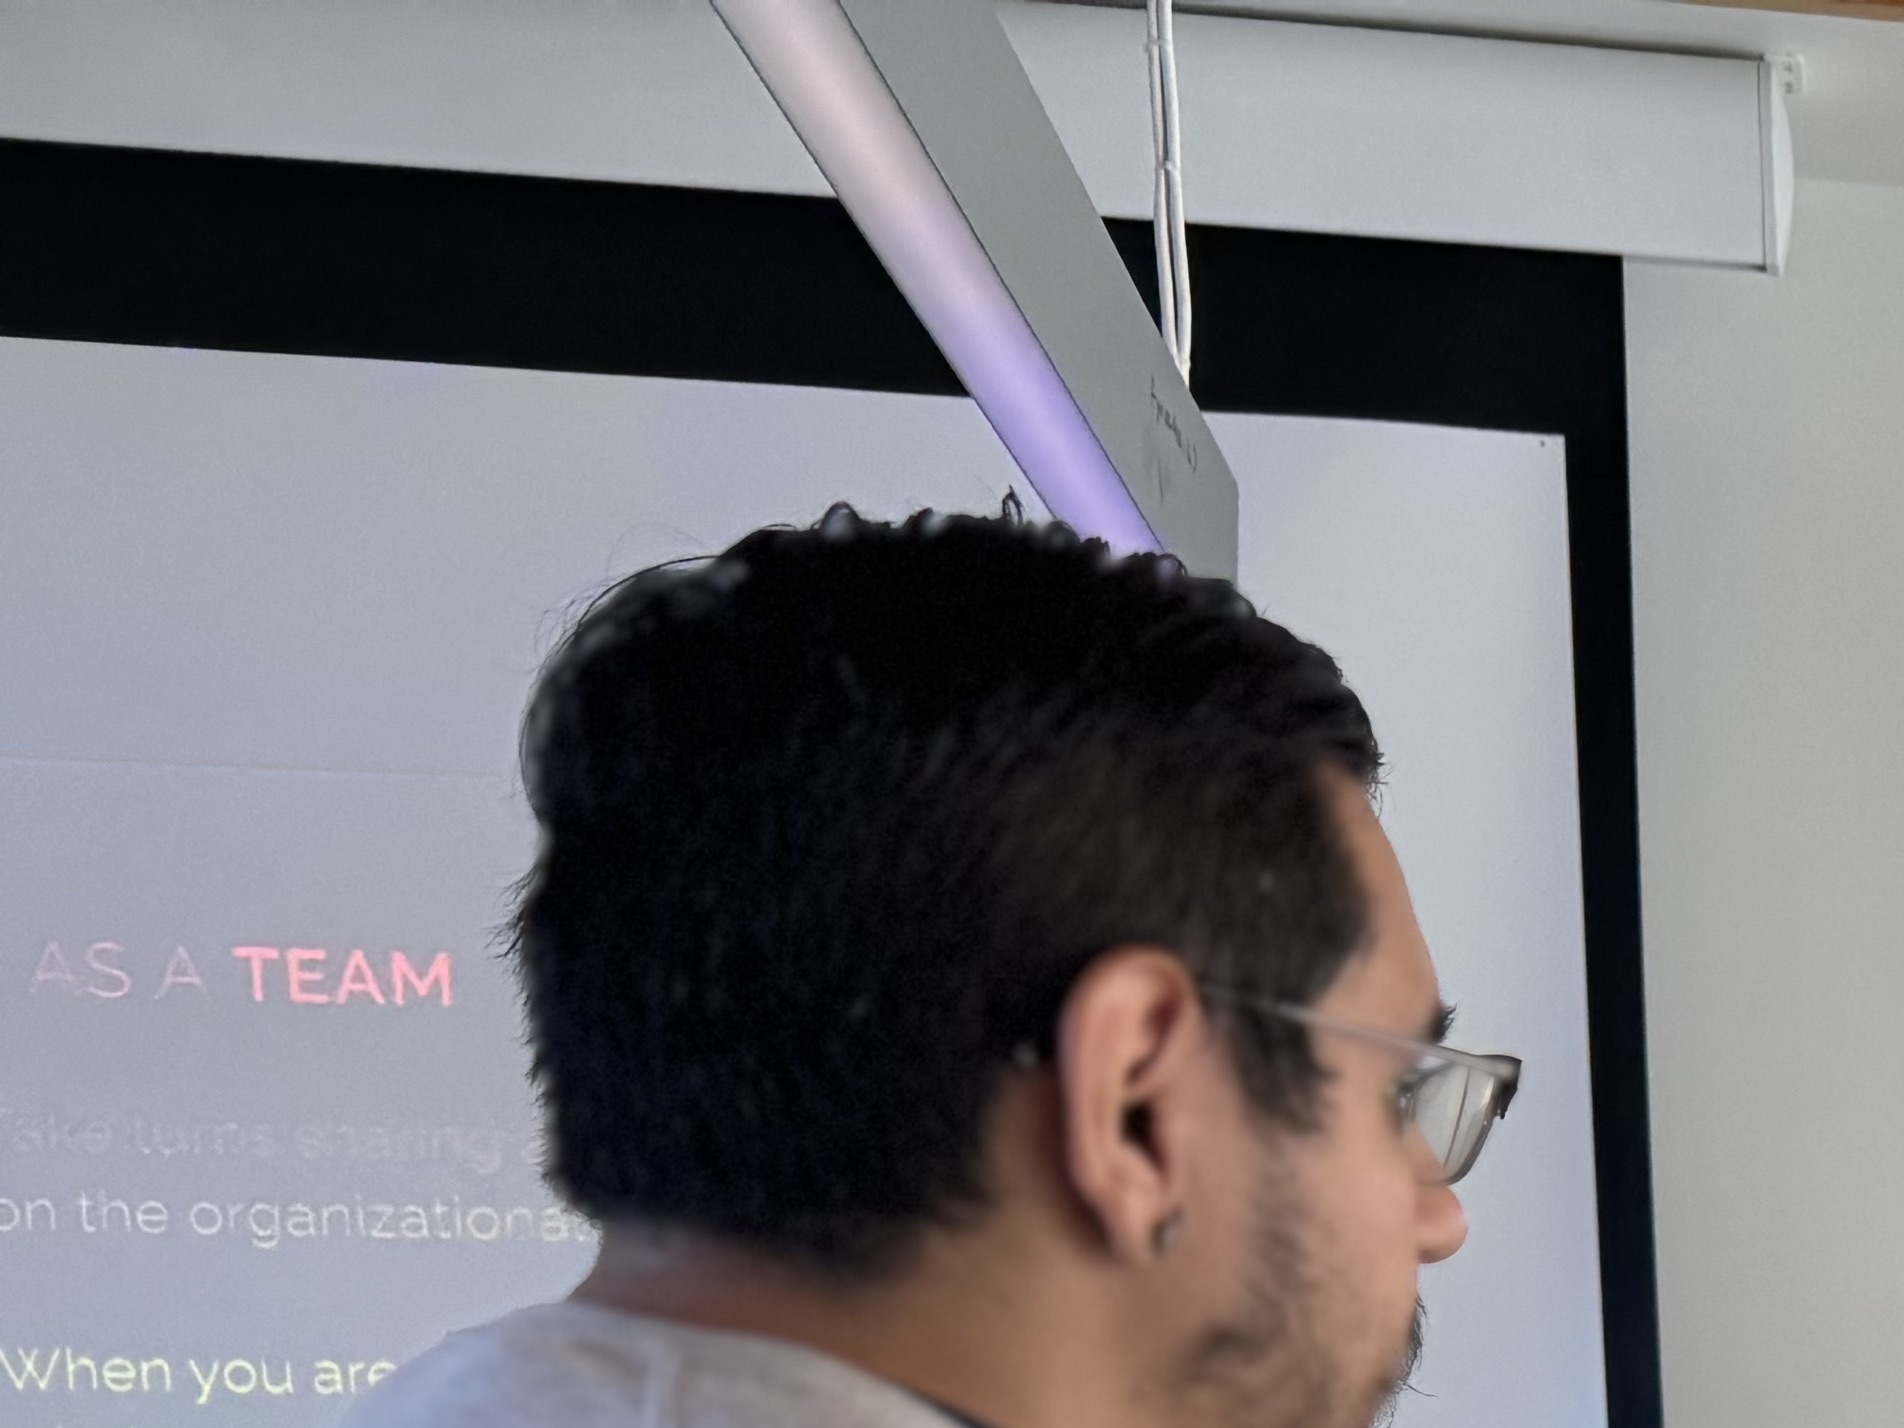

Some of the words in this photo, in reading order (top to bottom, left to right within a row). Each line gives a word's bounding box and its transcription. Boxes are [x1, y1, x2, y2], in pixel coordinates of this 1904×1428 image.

[29, 940, 132, 1000] AS
[153, 944, 208, 1003] A
[231, 945, 453, 1007] TEAM
[0, 1198, 55, 1231] on
[77, 1189, 168, 1233] the
[190, 1194, 586, 1249] organizationa
[0, 1347, 171, 1392] When
[189, 1359, 293, 1404] you
